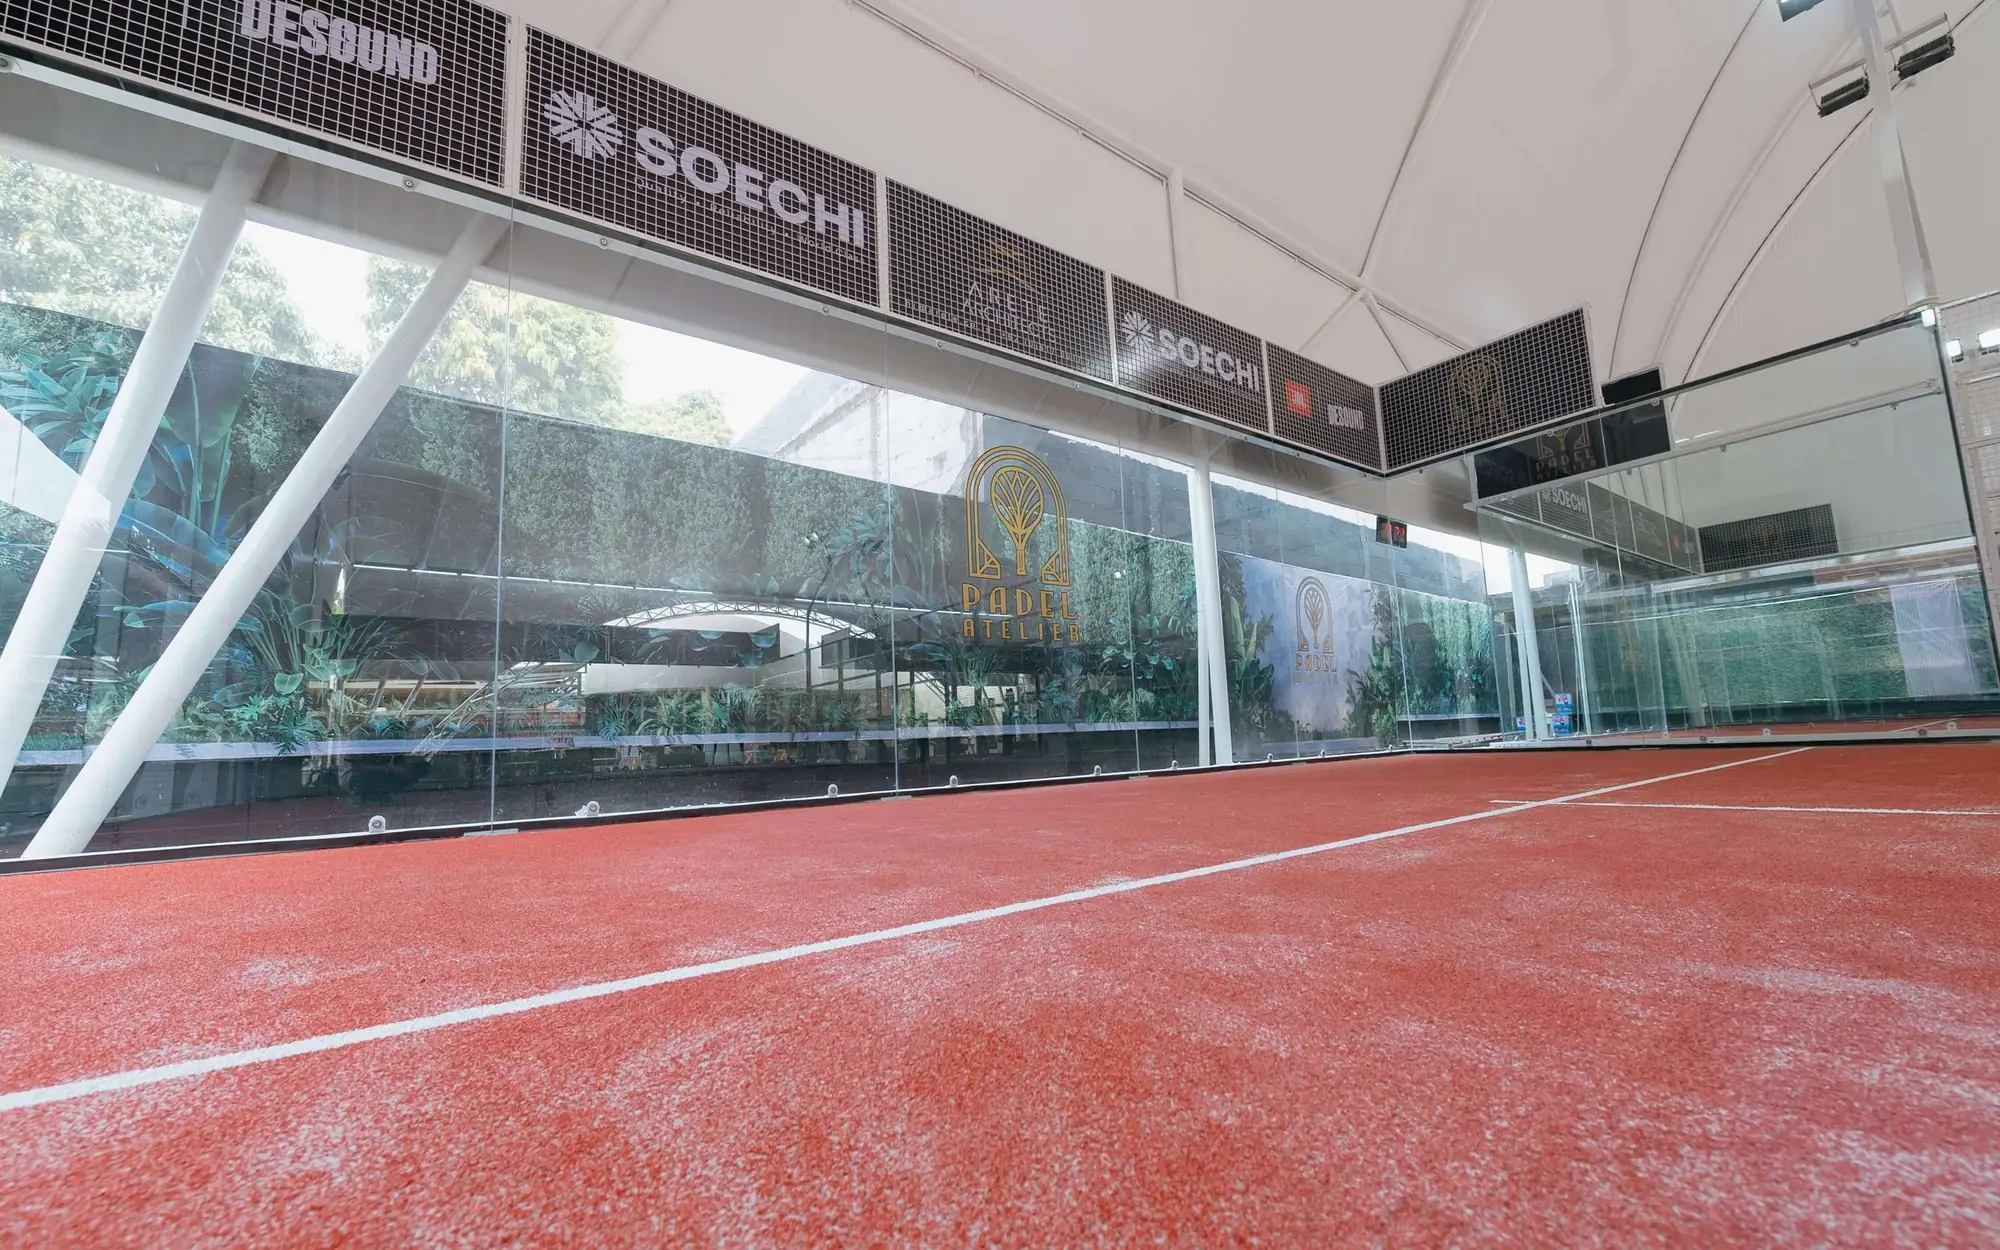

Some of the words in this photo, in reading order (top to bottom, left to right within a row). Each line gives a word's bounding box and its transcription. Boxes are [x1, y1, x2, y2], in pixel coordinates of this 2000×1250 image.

[240, 0, 438, 85] DESOUND
[634, 175, 686, 203] Quality
[635, 126, 865, 249] SOECHI
[968, 281, 1050, 323] ARETE
[1158, 328, 1260, 392] SOECHI
[962, 583, 1079, 619] PADEL
[963, 618, 1080, 643] ATELIER
[1295, 652, 1338, 673] PADEL
